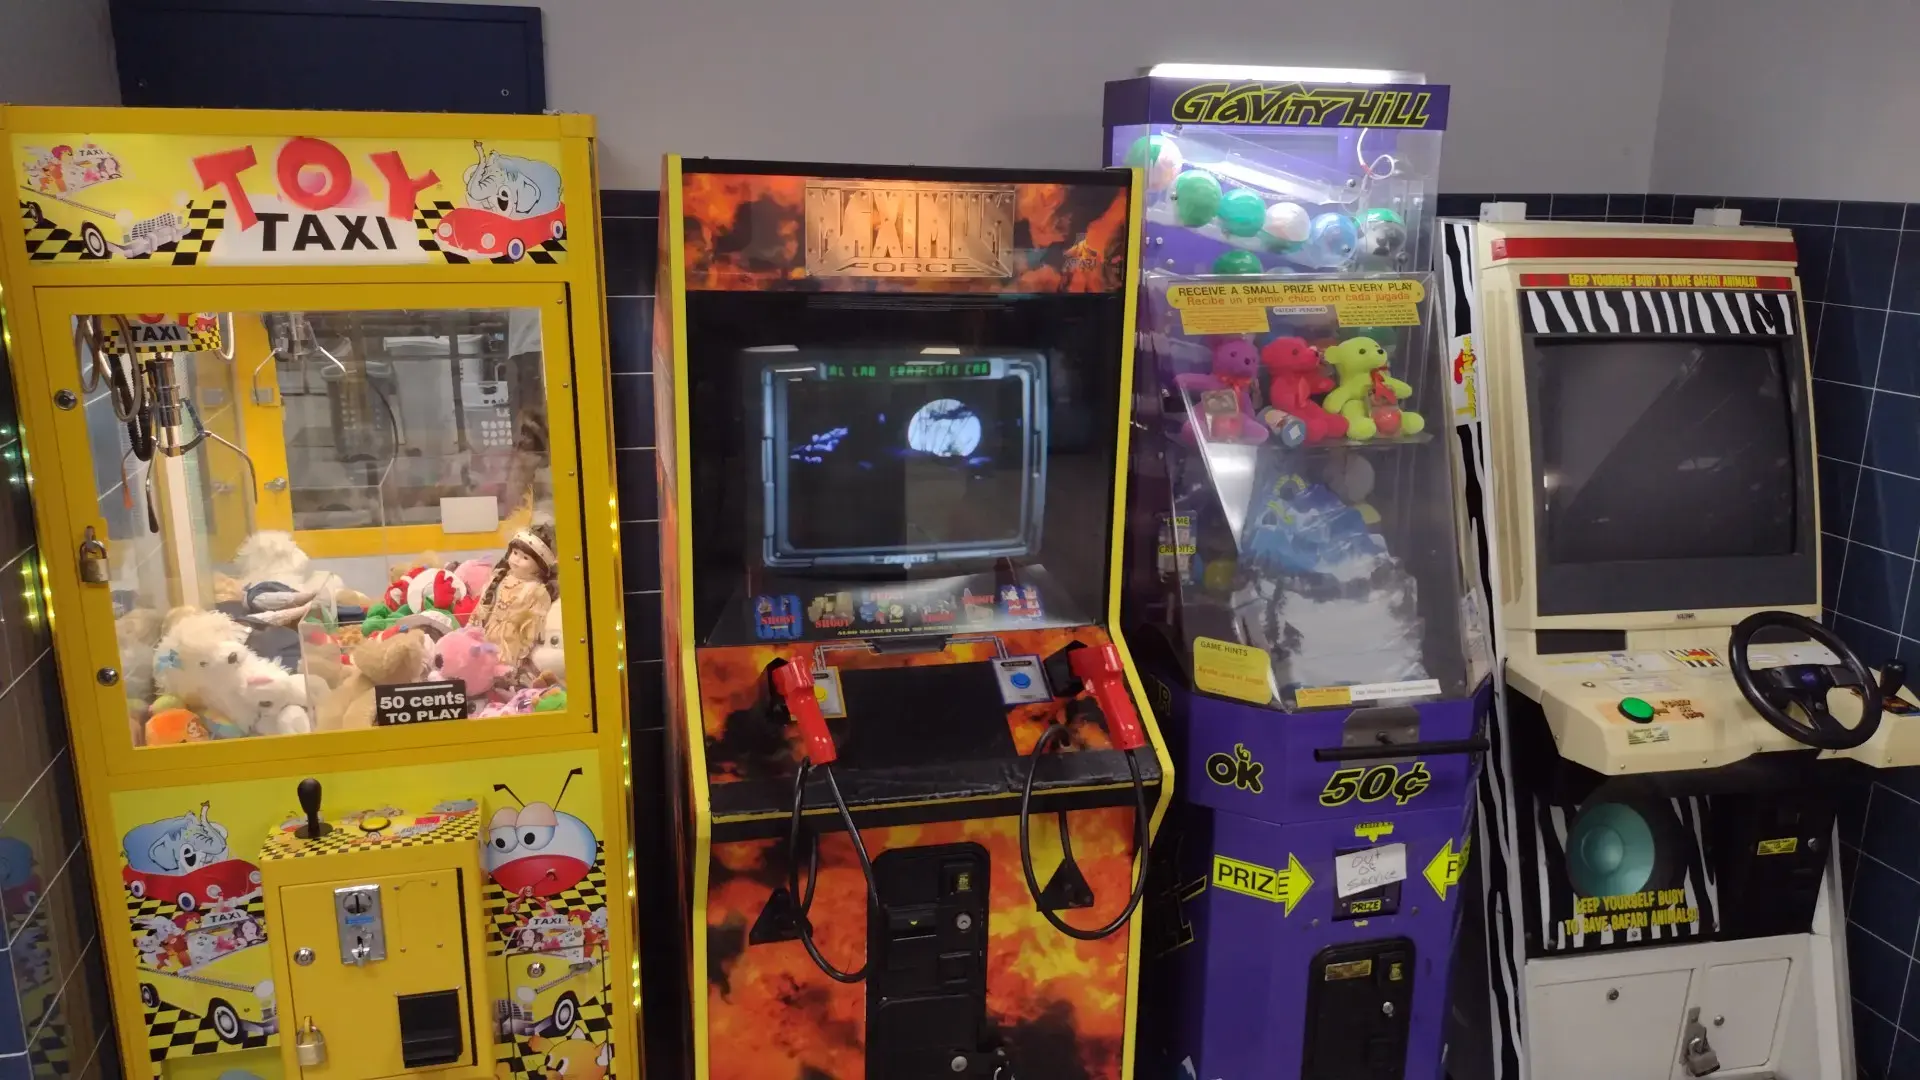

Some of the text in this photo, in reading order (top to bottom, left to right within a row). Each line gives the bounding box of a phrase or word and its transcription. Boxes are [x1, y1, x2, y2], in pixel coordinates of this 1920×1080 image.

[193, 136, 441, 232] TOY
[806, 188, 1014, 258] MAXIMUM
[255, 212, 398, 252] TAXI
[836, 261, 984, 273] FORCE
[1658, 275, 1669, 286] TO
[1178, 282, 1413, 297] RECEIVE A SMALL PRIZE WITH EVERY PLAY
[1187, 296, 1225, 306] Recibe
[1247, 294, 1284, 307] premio
[1288, 294, 1317, 303] chico
[1321, 294, 1341, 302] con
[1345, 292, 1371, 301] cada
[1375, 291, 1410, 303] jugada
[128, 325, 181, 342] TAXI
[1200, 640, 1248, 657] GAME HINTS
[380, 691, 465, 710] 50 cents
[386, 708, 462, 724] TO PLAY
[1206, 753, 1263, 794] OK
[1320, 762, 1432, 806] 50¢
[1217, 863, 1289, 896] PRIZE
[1351, 900, 1381, 912] PRIZE
[210, 912, 241, 922] TAXI
[1565, 919, 1580, 935] TO
[1611, 911, 1648, 930] SAFARI
